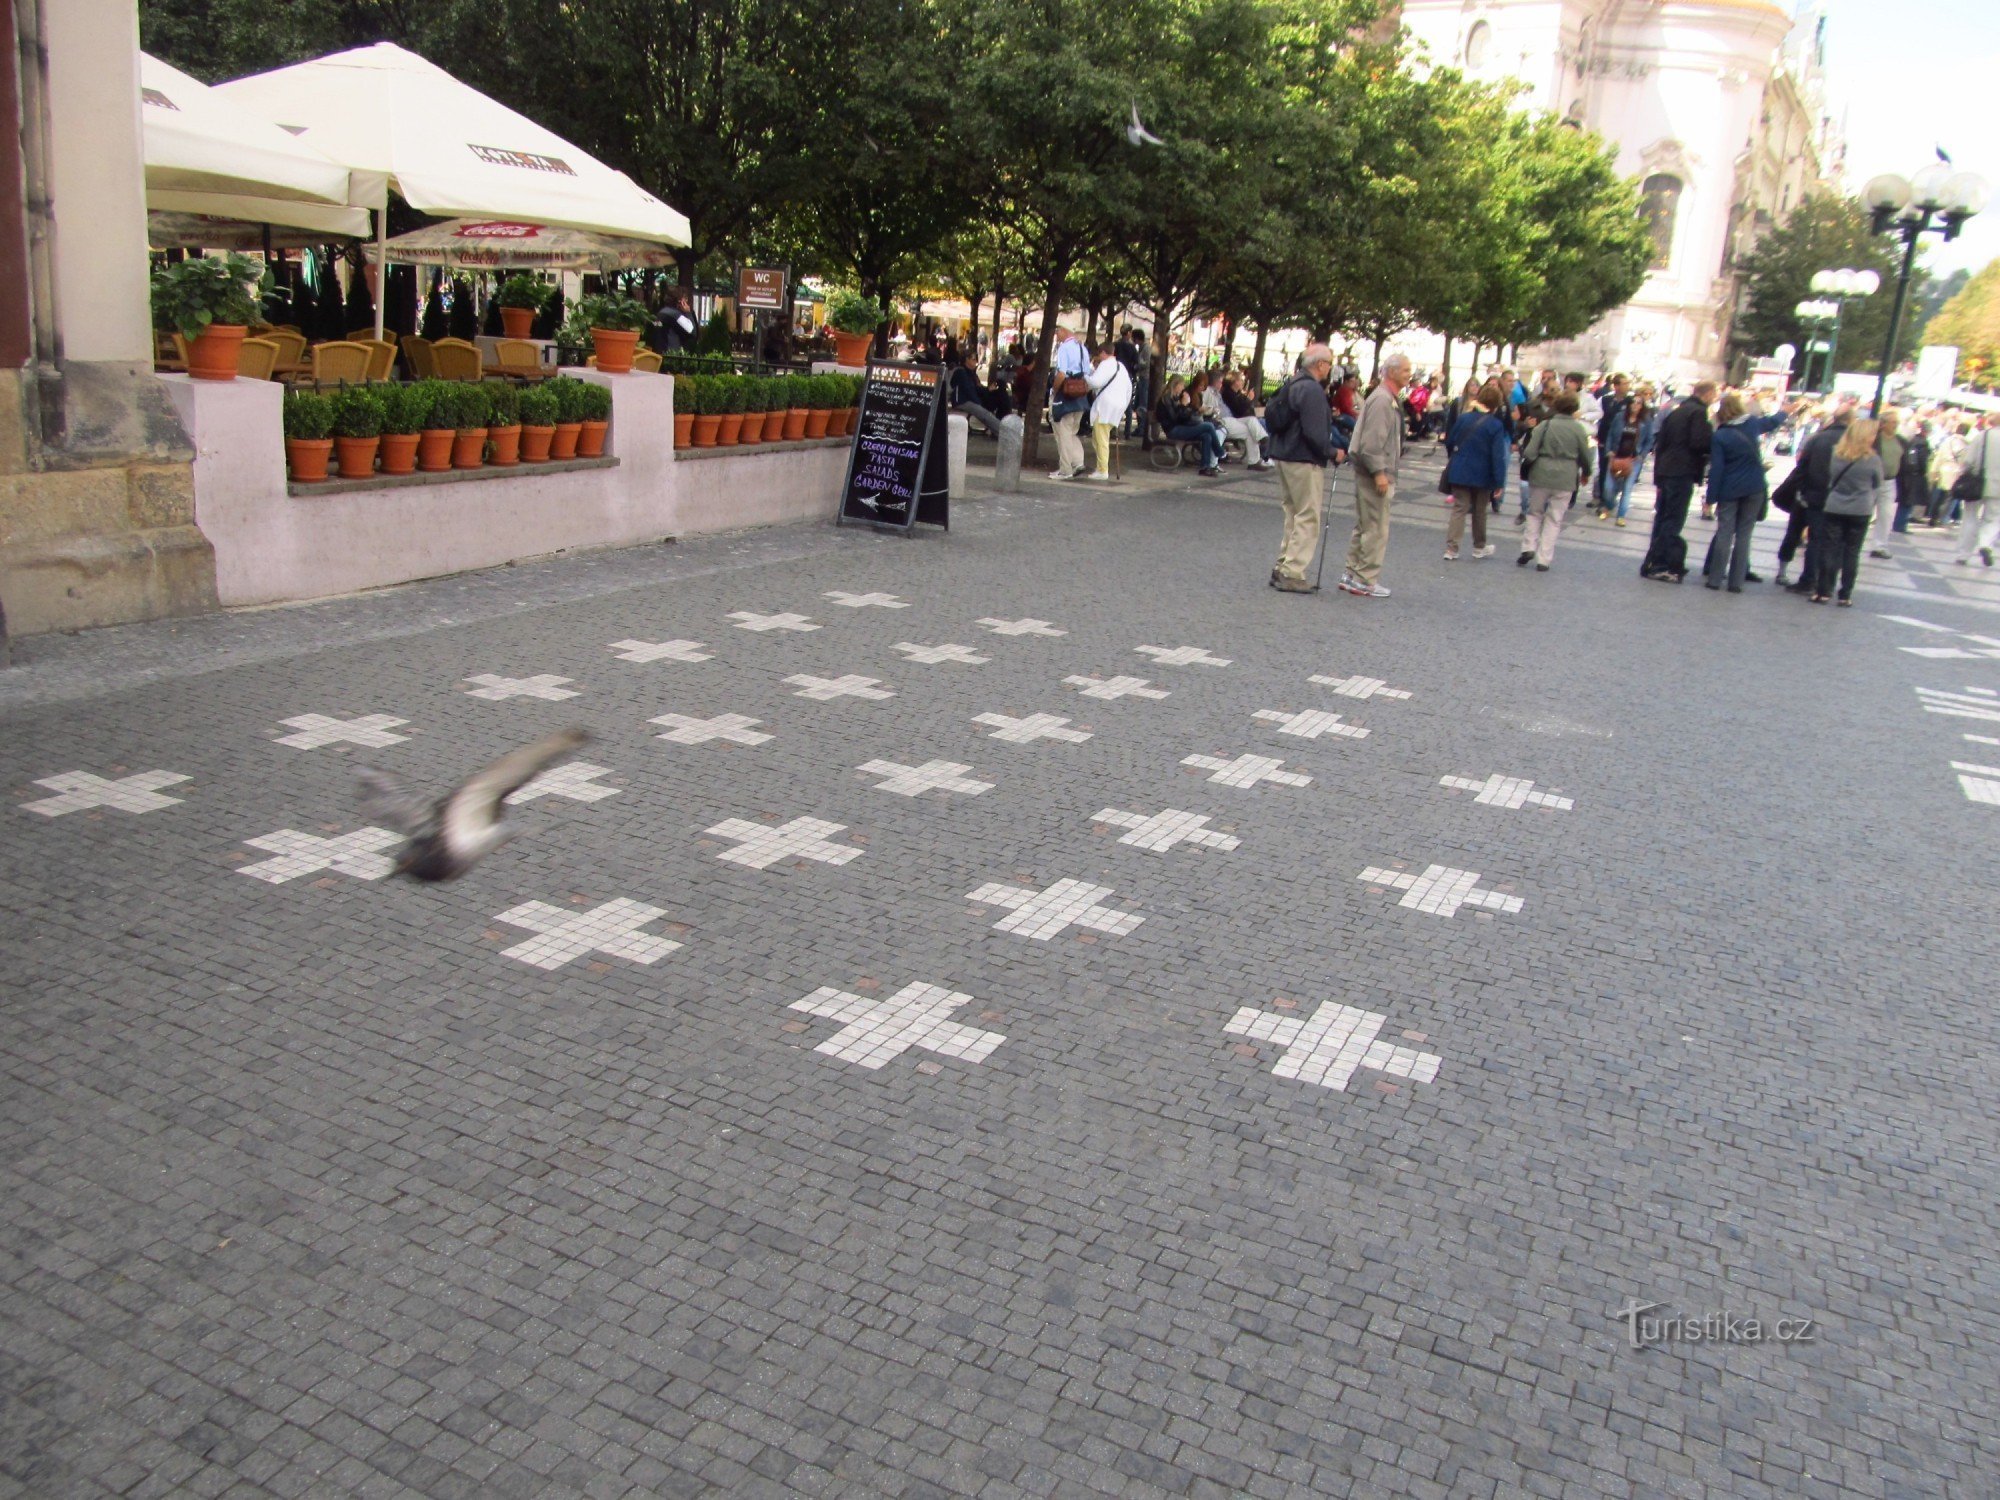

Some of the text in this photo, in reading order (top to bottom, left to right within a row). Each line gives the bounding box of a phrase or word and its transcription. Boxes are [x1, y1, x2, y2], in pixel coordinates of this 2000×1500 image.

[754, 272, 770, 283] WC
[861, 441, 919, 459] CZECH CUISINE
[869, 451, 895, 467] PASTA
[862, 464, 901, 482] SALADS
[853, 474, 913, 498] GARDEN GRILL
